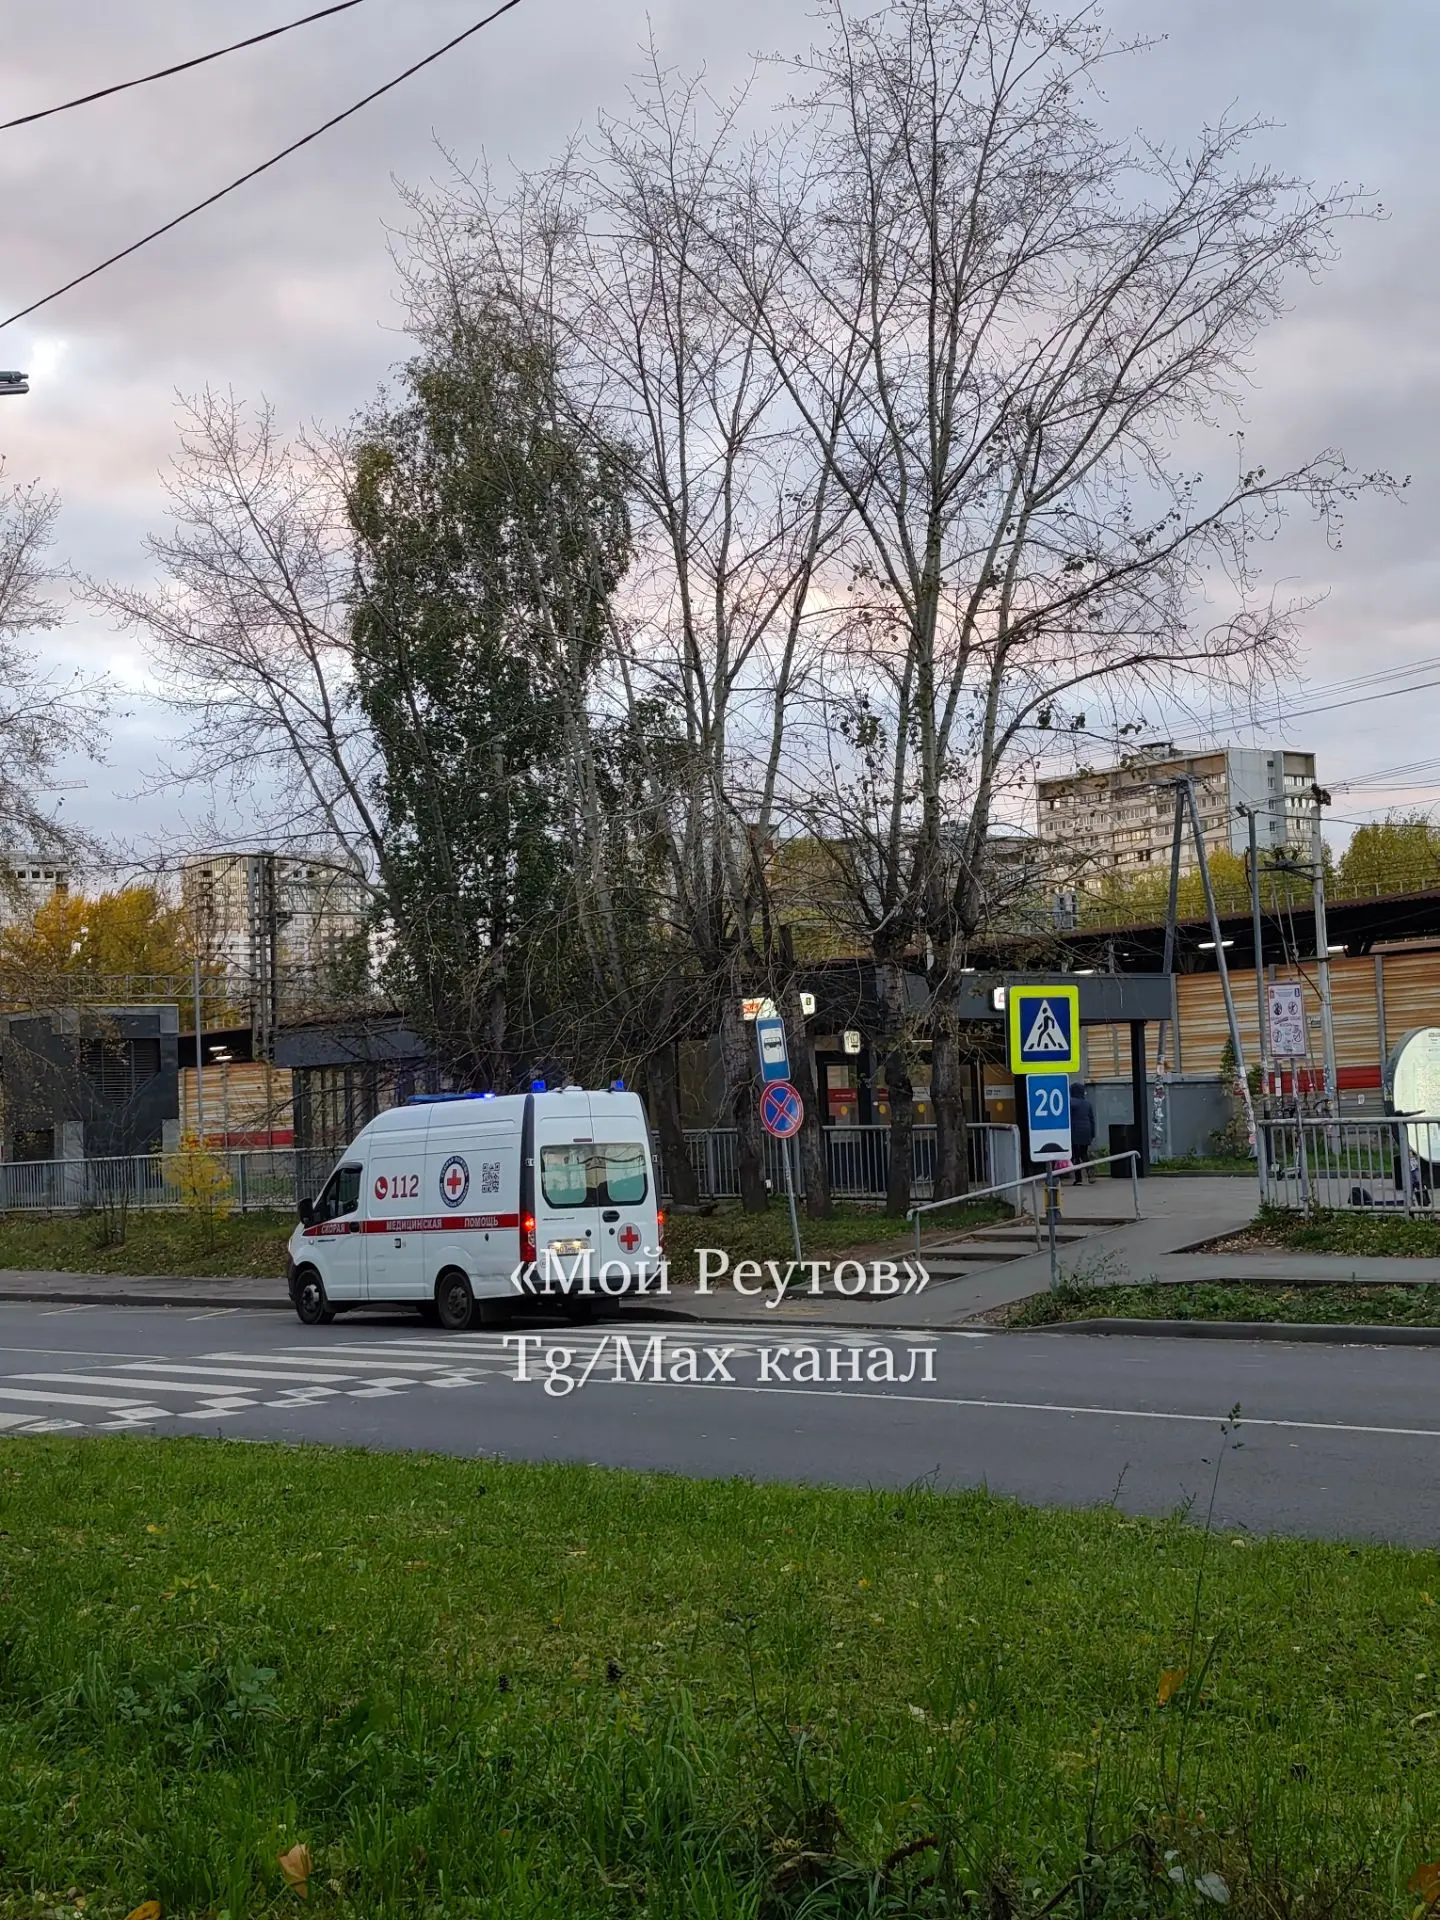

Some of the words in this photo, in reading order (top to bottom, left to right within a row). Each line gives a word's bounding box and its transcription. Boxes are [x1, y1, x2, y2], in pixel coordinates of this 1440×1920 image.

[1035, 1089, 1064, 1117] 20
[391, 1174, 419, 1199] 112
[321, 1222, 346, 1234] СКОРАЯ
[386, 1218, 442, 1231] МЕДИЦИНСКАЯ
[464, 1215, 499, 1229] ПОМОЩЬ
